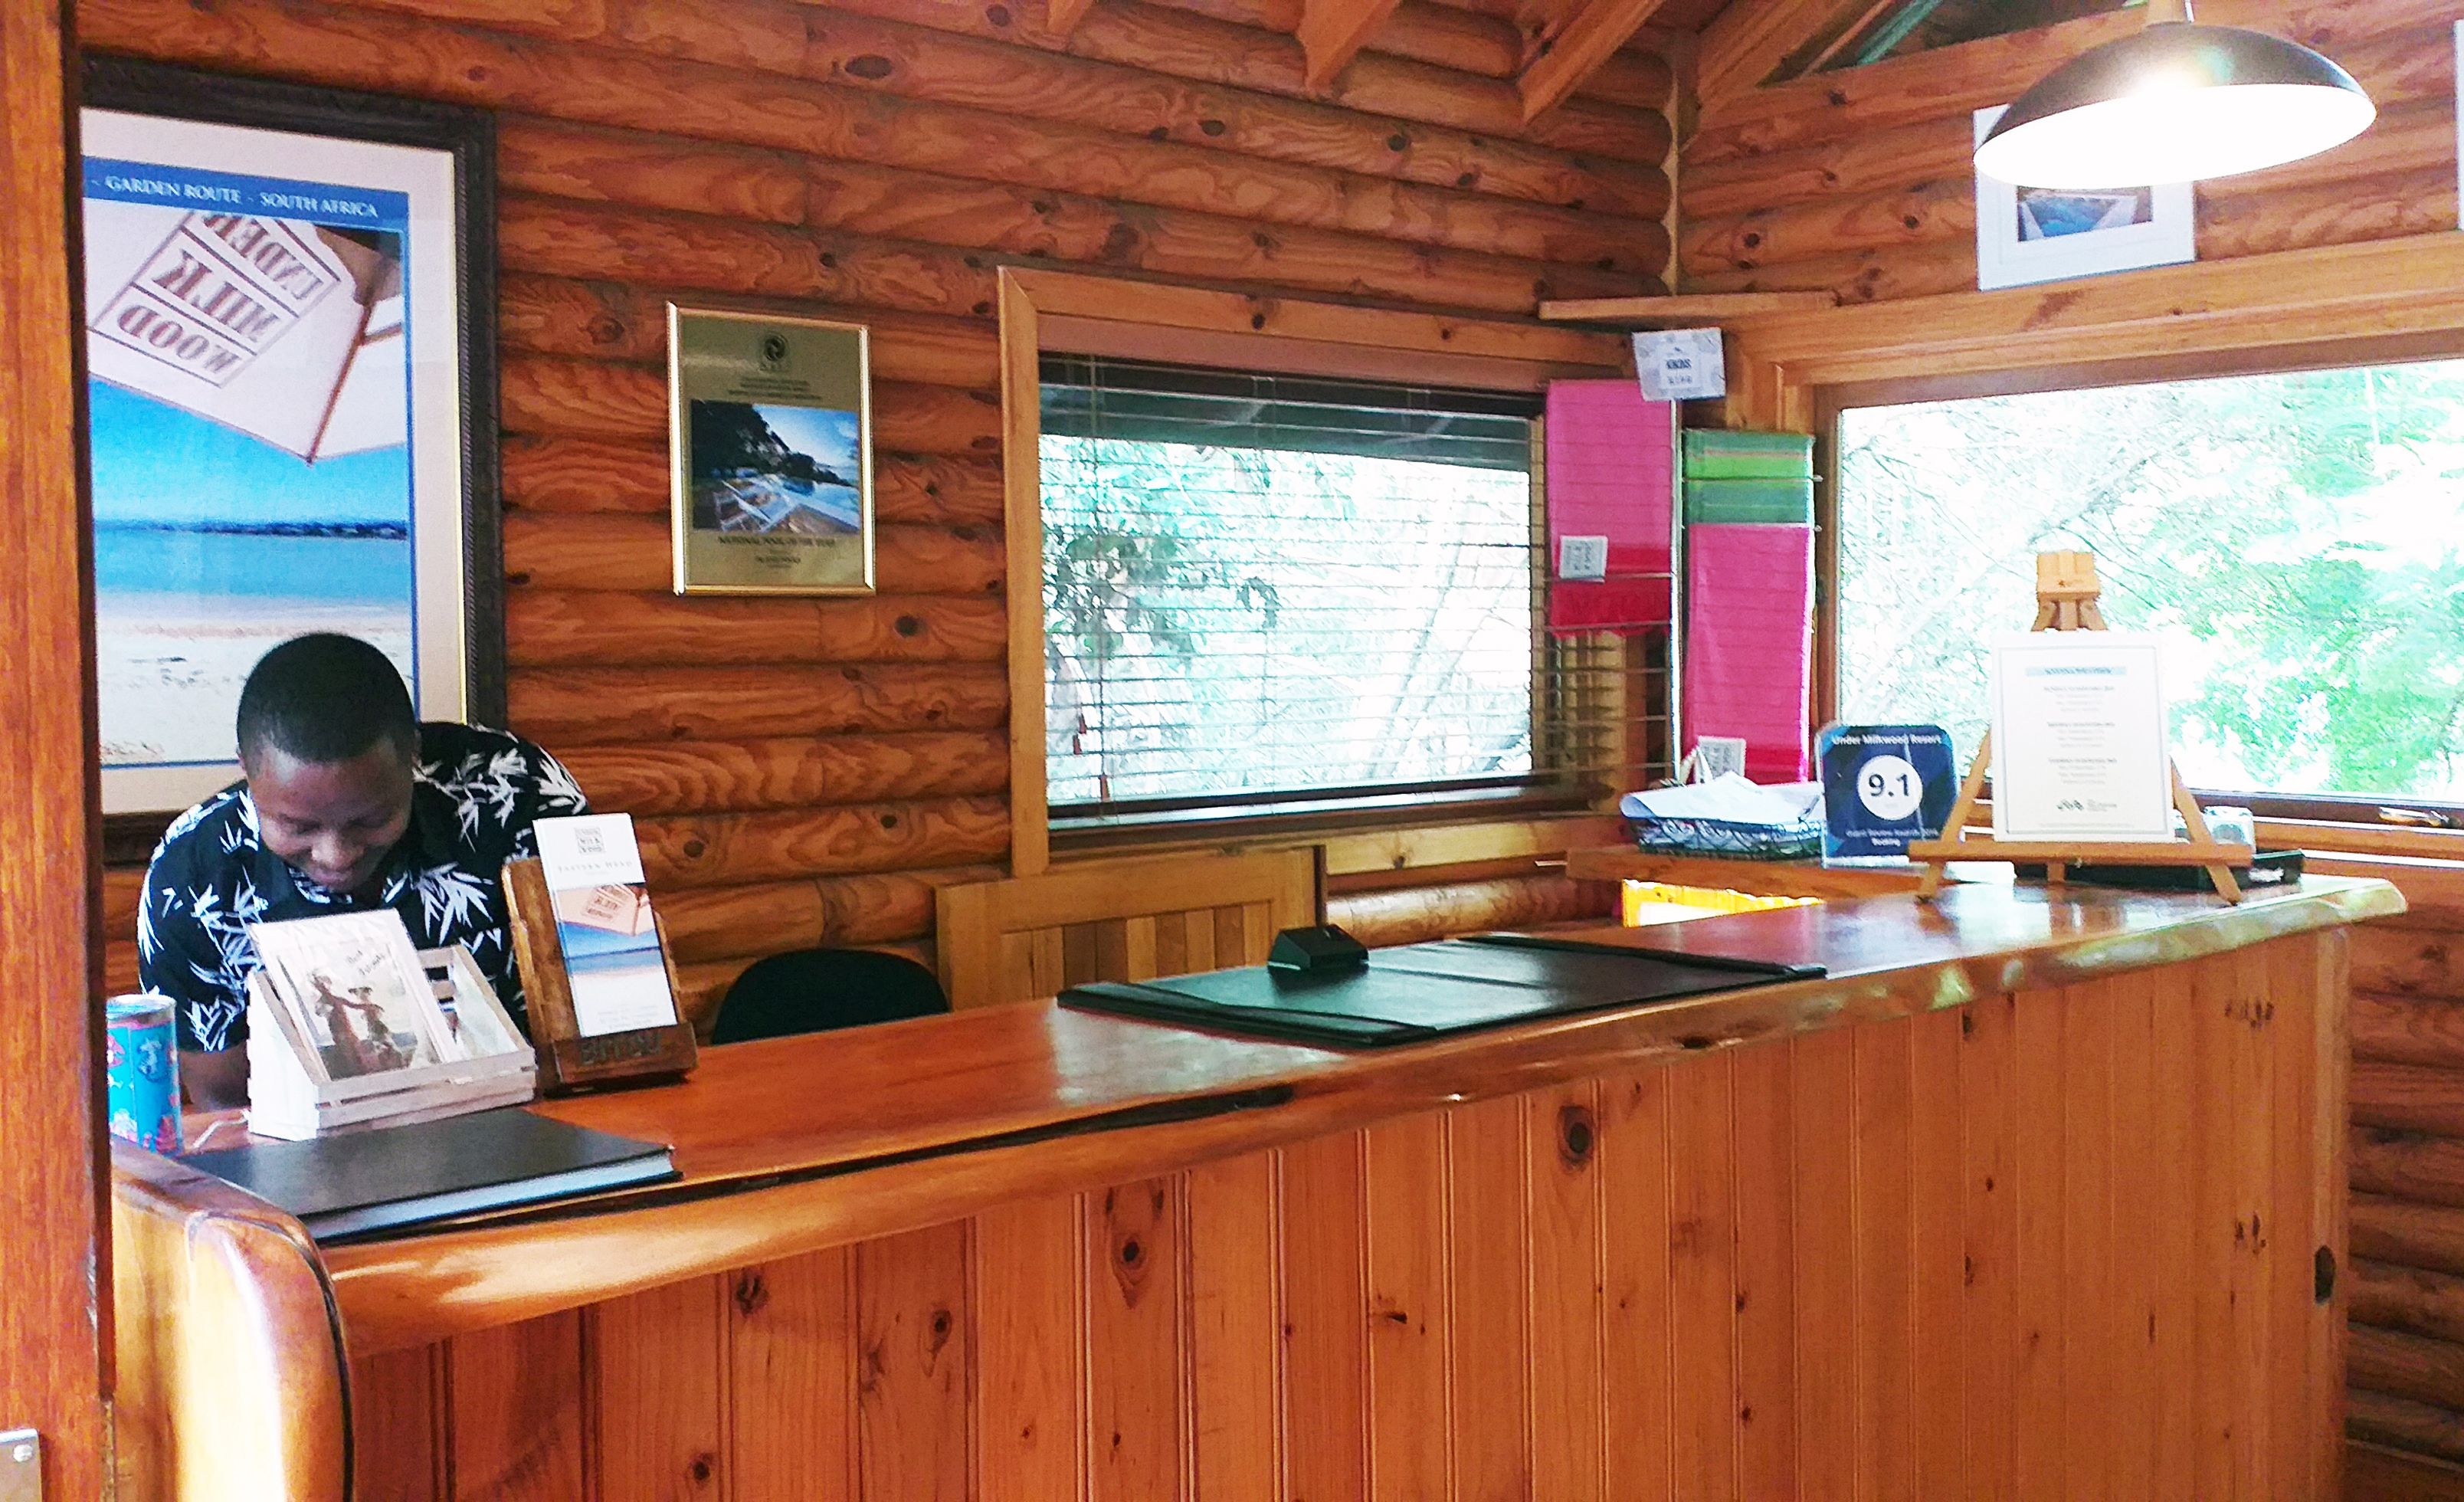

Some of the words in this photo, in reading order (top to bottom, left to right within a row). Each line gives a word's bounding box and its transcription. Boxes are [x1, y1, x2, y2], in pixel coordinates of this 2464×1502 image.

[104, 175, 181, 197] GARDEN
[183, 183, 243, 205] ROUTE
[260, 192, 318, 212] SOUTH
[319, 199, 378, 218] AFRICA
[1831, 735, 1861, 746] Under
[1862, 733, 1909, 746] Milkwood
[1910, 734, 1942, 745] Resort
[1867, 773, 1910, 798] 9.1
